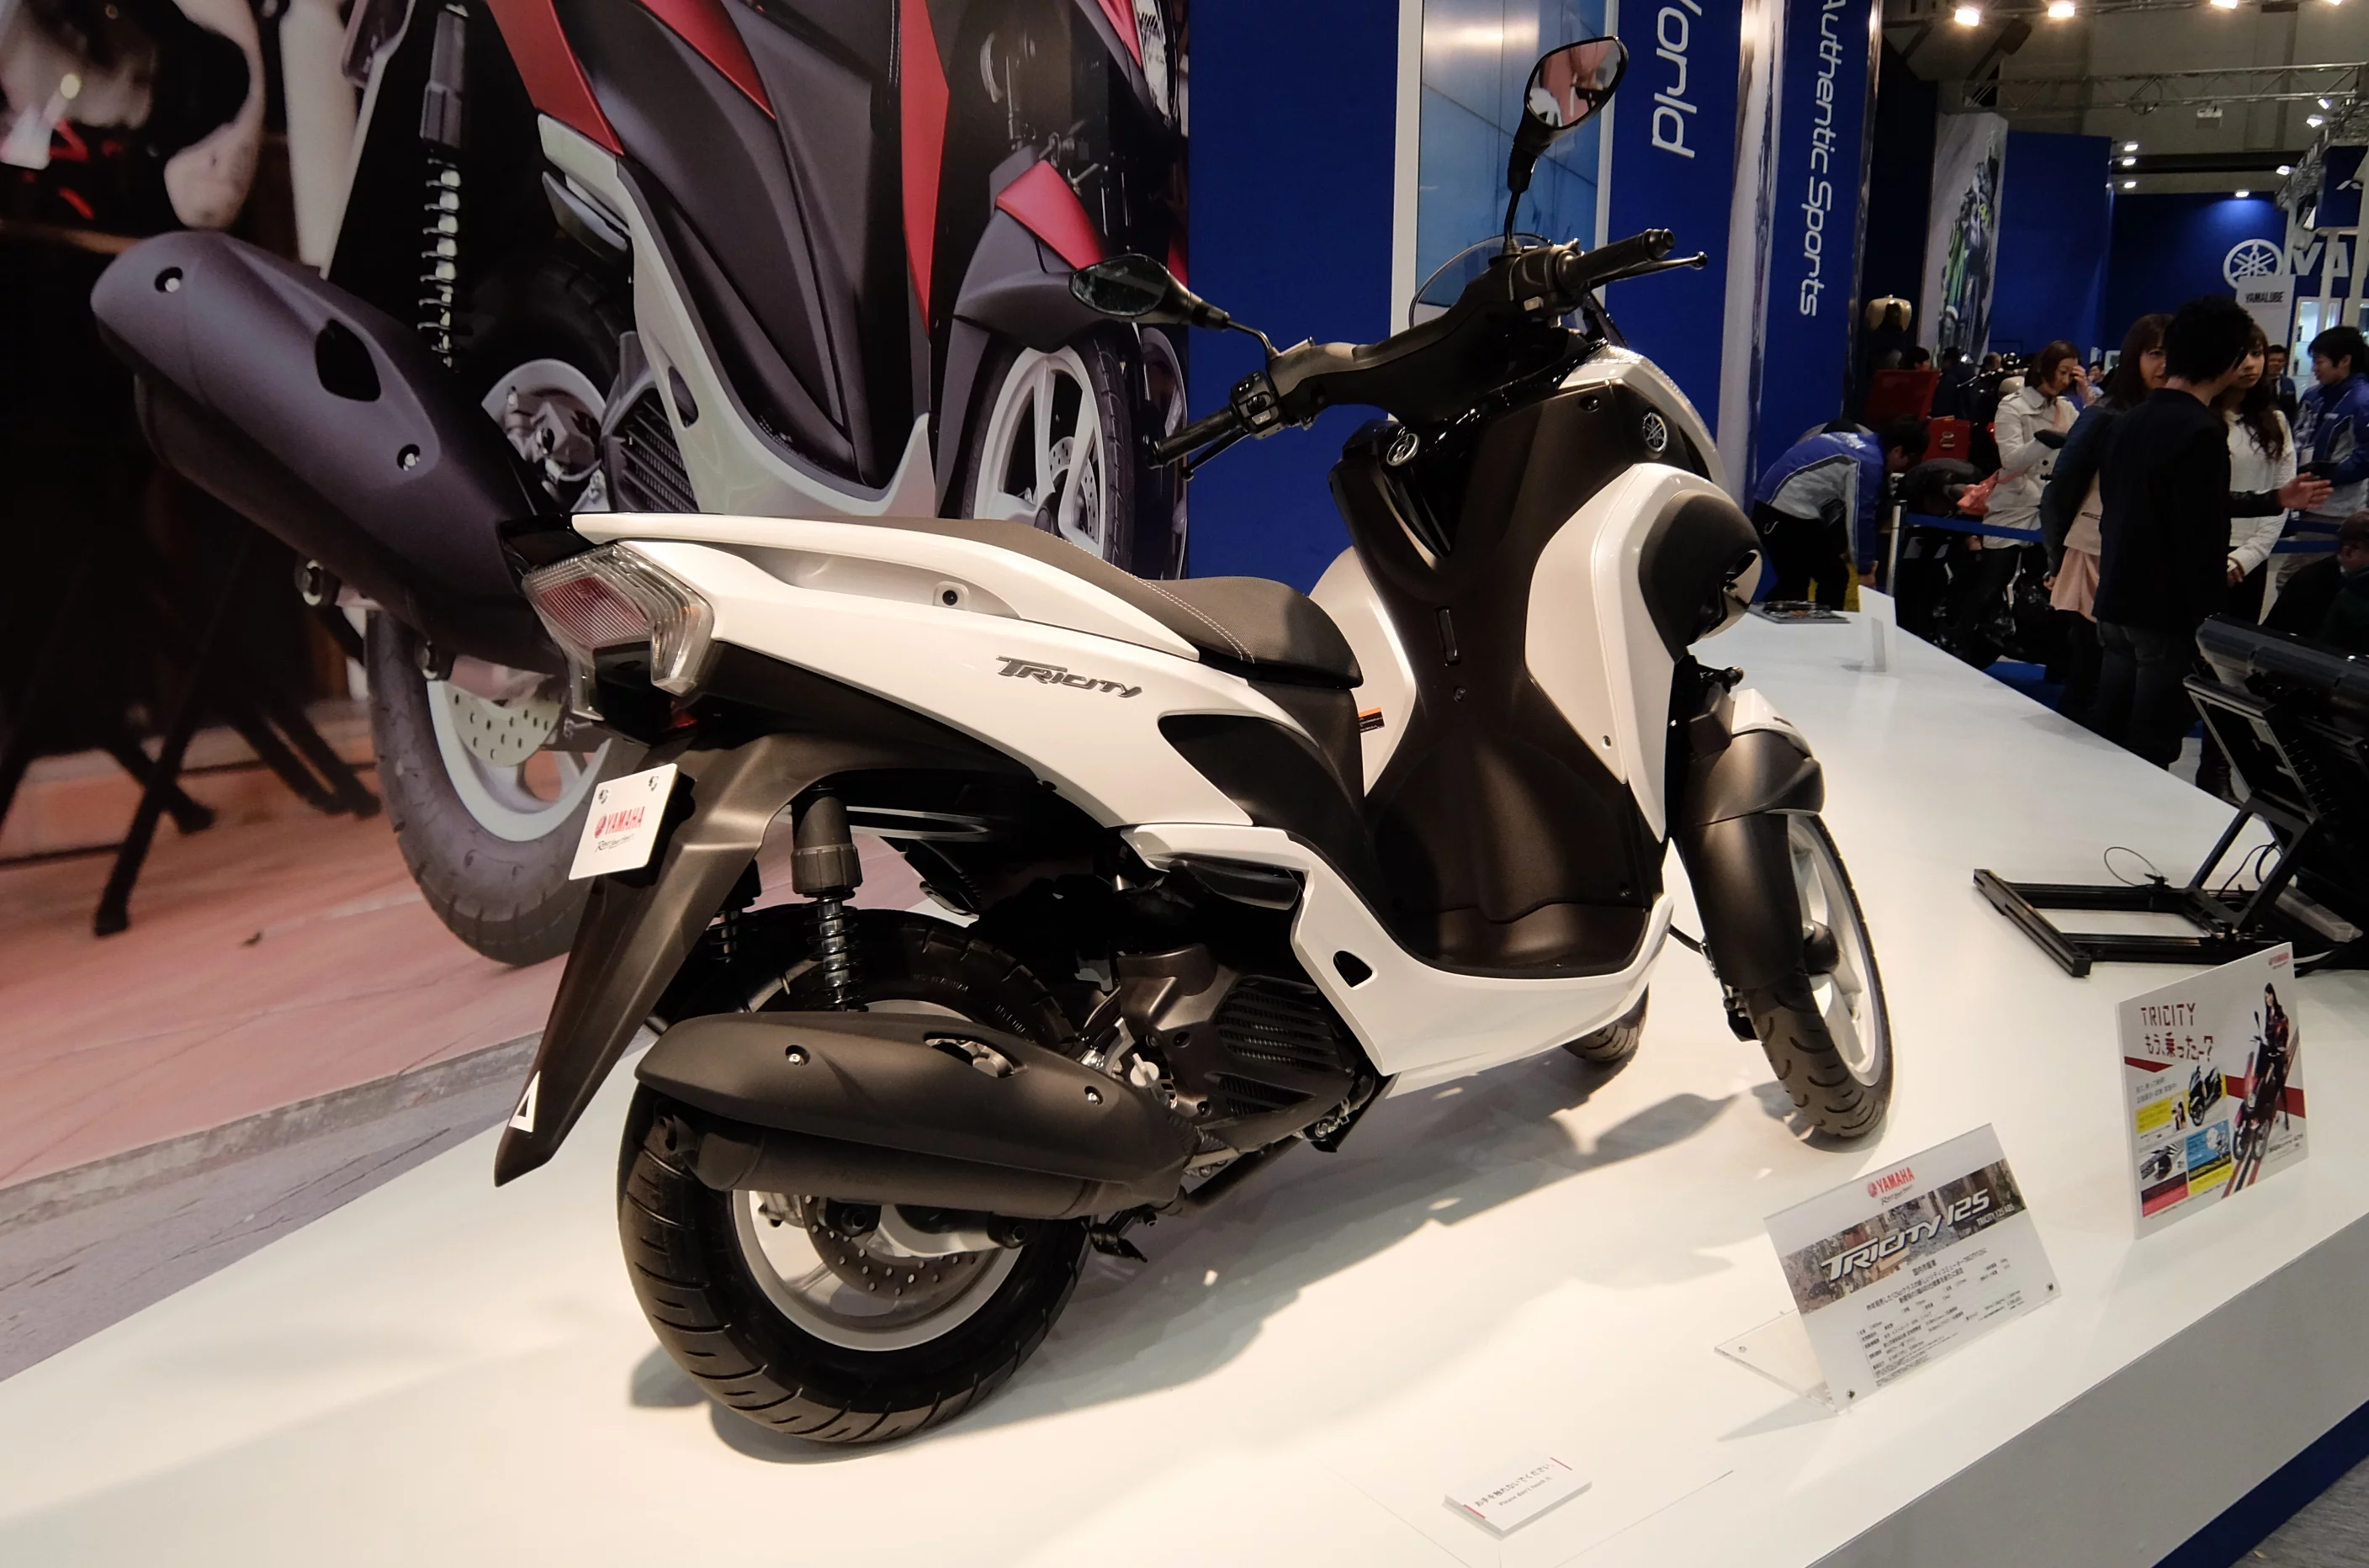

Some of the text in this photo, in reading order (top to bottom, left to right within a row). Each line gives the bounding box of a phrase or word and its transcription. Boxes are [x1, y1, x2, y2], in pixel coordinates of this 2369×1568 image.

[1651, 0, 1703, 159] orld
[1799, 0, 1847, 317] Authentic Sports
[605, 805, 645, 834] YAMAHA
[2140, 1003, 2196, 1026] TRICITY
[1876, 1167, 1915, 1193] YAMAHA
[1820, 1189, 1990, 1281] TRICITY 125
